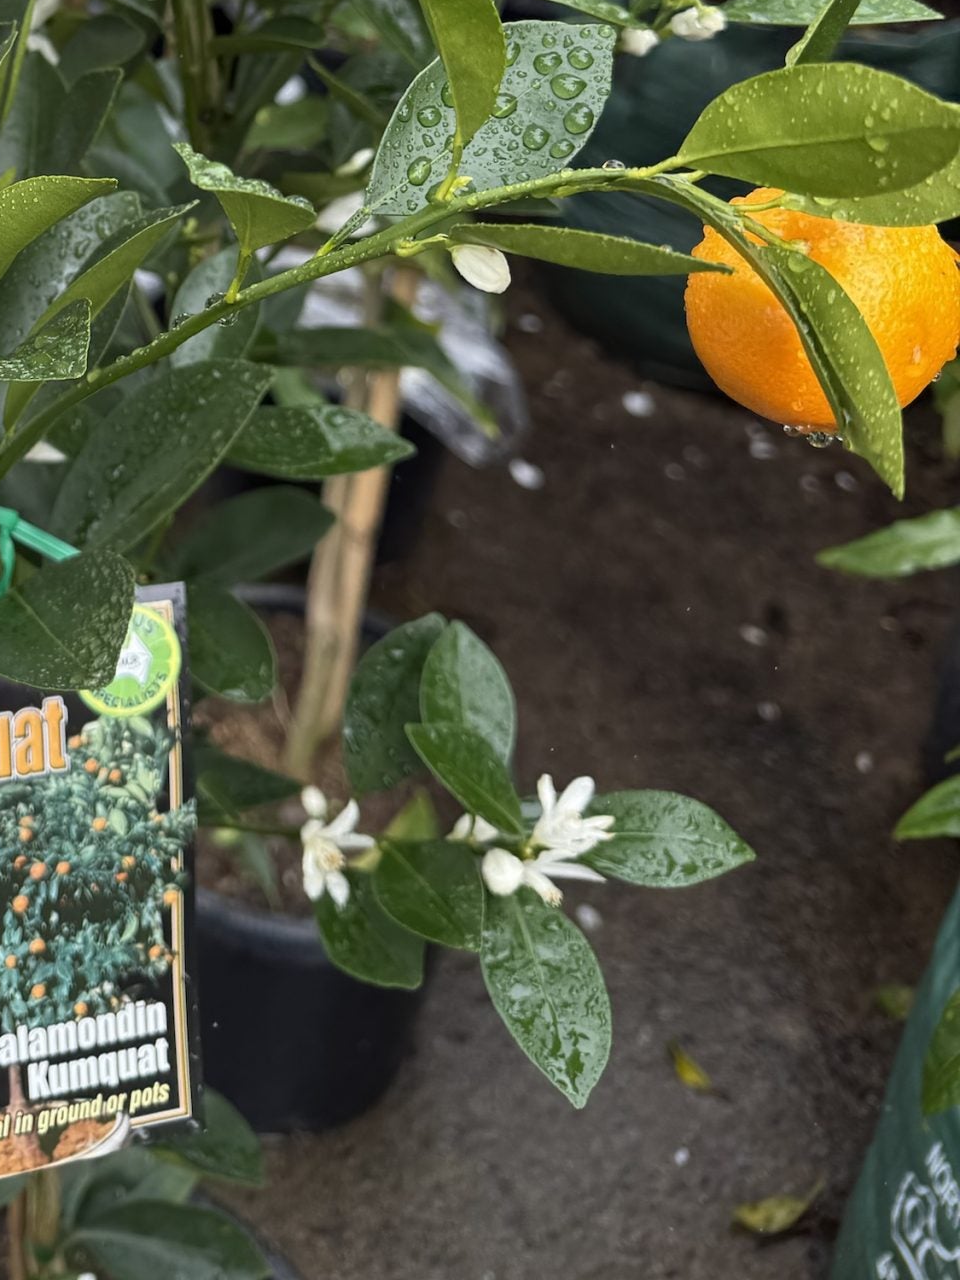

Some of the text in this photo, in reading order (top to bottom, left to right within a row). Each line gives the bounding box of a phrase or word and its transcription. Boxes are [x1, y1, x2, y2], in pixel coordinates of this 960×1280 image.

[92, 673, 168, 709] PECIALISTS
[27, 1037, 171, 1101] Kumquat
[14, 1111, 33, 1134] in
[37, 1093, 104, 1134] ground
[105, 1092, 128, 1113] or
[128, 1081, 171, 1114] pots
